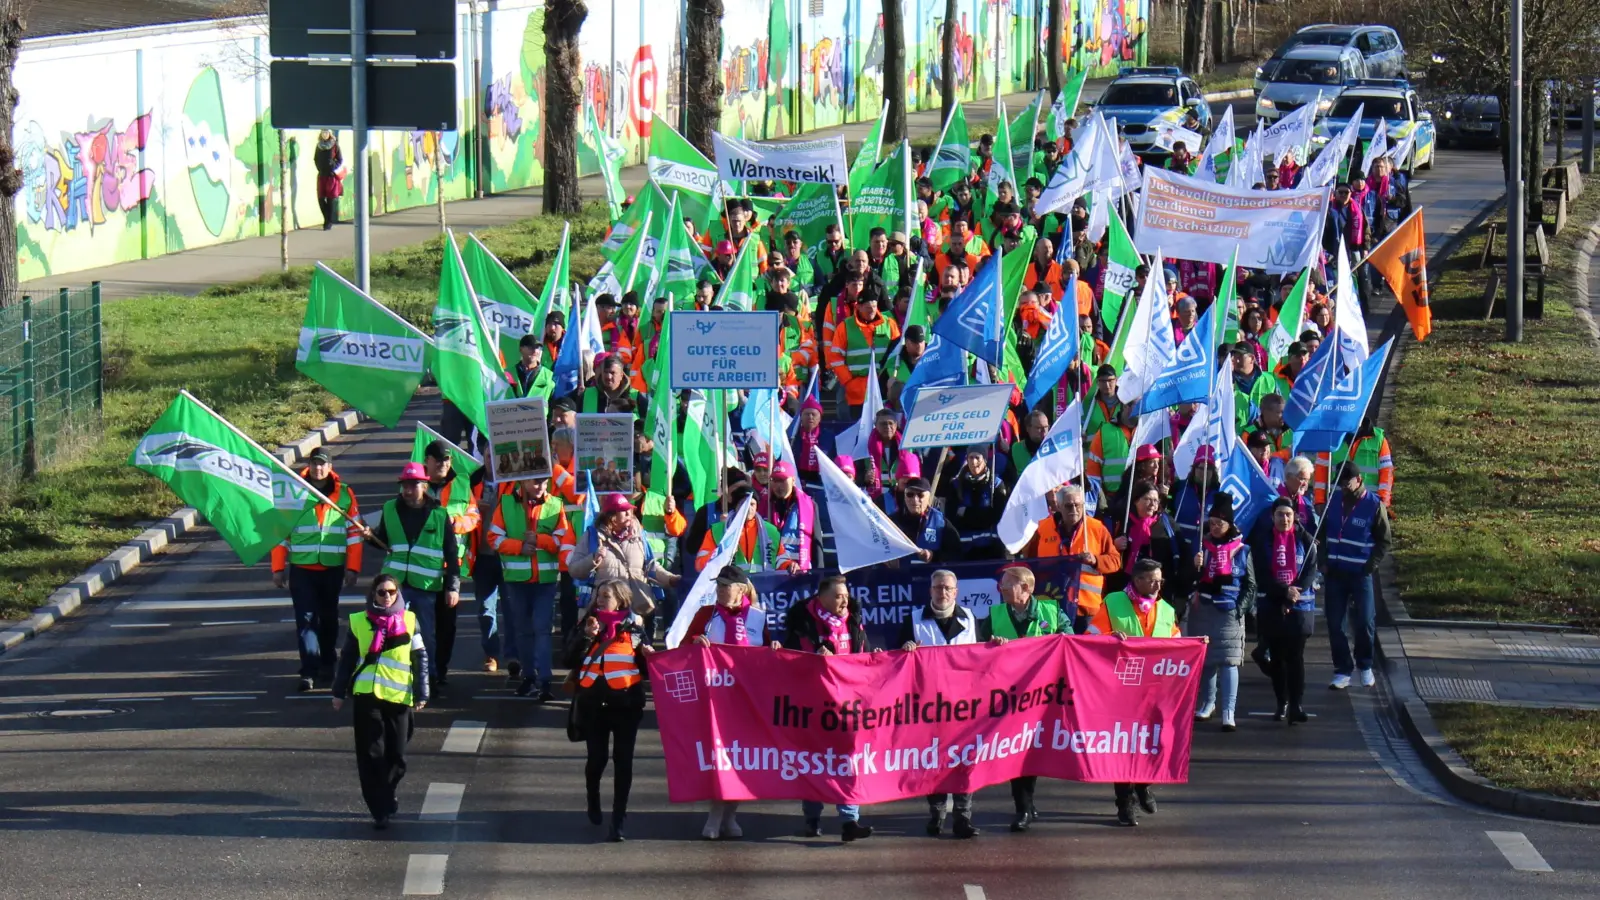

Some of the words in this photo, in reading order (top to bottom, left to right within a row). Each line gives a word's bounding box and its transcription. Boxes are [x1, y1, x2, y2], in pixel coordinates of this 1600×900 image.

[729, 158, 836, 183] Warnstreik!
[1150, 177, 1321, 209] Justizvollzugsbedienstete
[1148, 198, 1215, 218] verdienen
[1146, 212, 1249, 238] Wertschätzung!
[687, 345, 727, 356] GUTES
[730, 345, 761, 356] GELD
[711, 356, 737, 370] FÜR
[682, 371, 714, 382] GUTE
[717, 371, 767, 382] ARBEIT!
[923, 411, 960, 422] GUTES
[962, 409, 991, 419] GELD
[941, 420, 966, 431] FÜR
[912, 432, 943, 443] GUTE
[944, 430, 989, 441] ARBEIT!
[1277, 544, 1287, 567] dbb
[877, 583, 913, 603] EIN
[960, 592, 993, 607] +7%
[704, 667, 735, 688] dbb
[1152, 658, 1191, 678] dbb
[772, 695, 814, 729] Ihr
[820, 690, 982, 733] öffentlicher
[988, 677, 1075, 719] Dienst:
[695, 738, 878, 781] Listungsstark
[884, 737, 939, 771] und
[947, 719, 1044, 768] schlecht
[1051, 719, 1161, 755] bezahlt!
